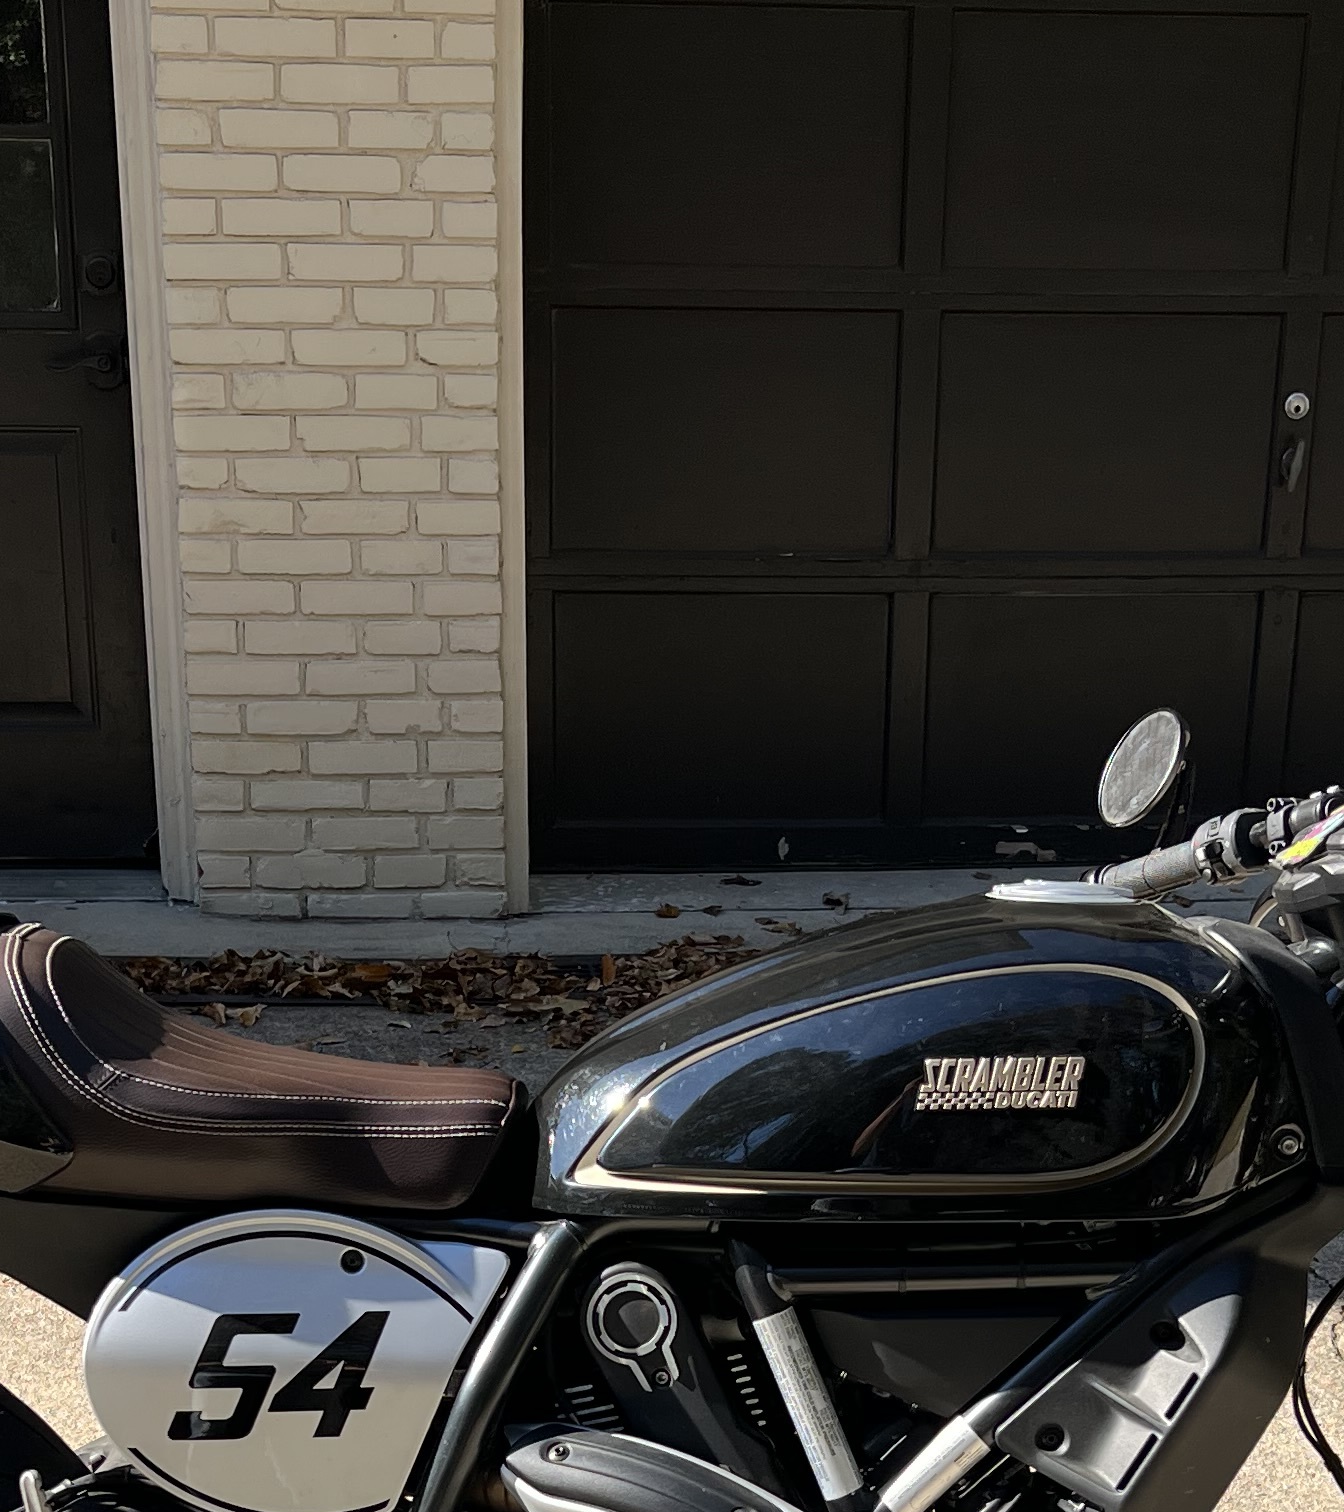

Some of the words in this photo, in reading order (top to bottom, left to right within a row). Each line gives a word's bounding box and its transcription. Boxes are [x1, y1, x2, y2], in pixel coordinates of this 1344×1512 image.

[919, 1056, 1085, 1092] SCRAMBLER
[994, 1091, 1078, 1109] DUCATI
[168, 1311, 391, 1440] 54
